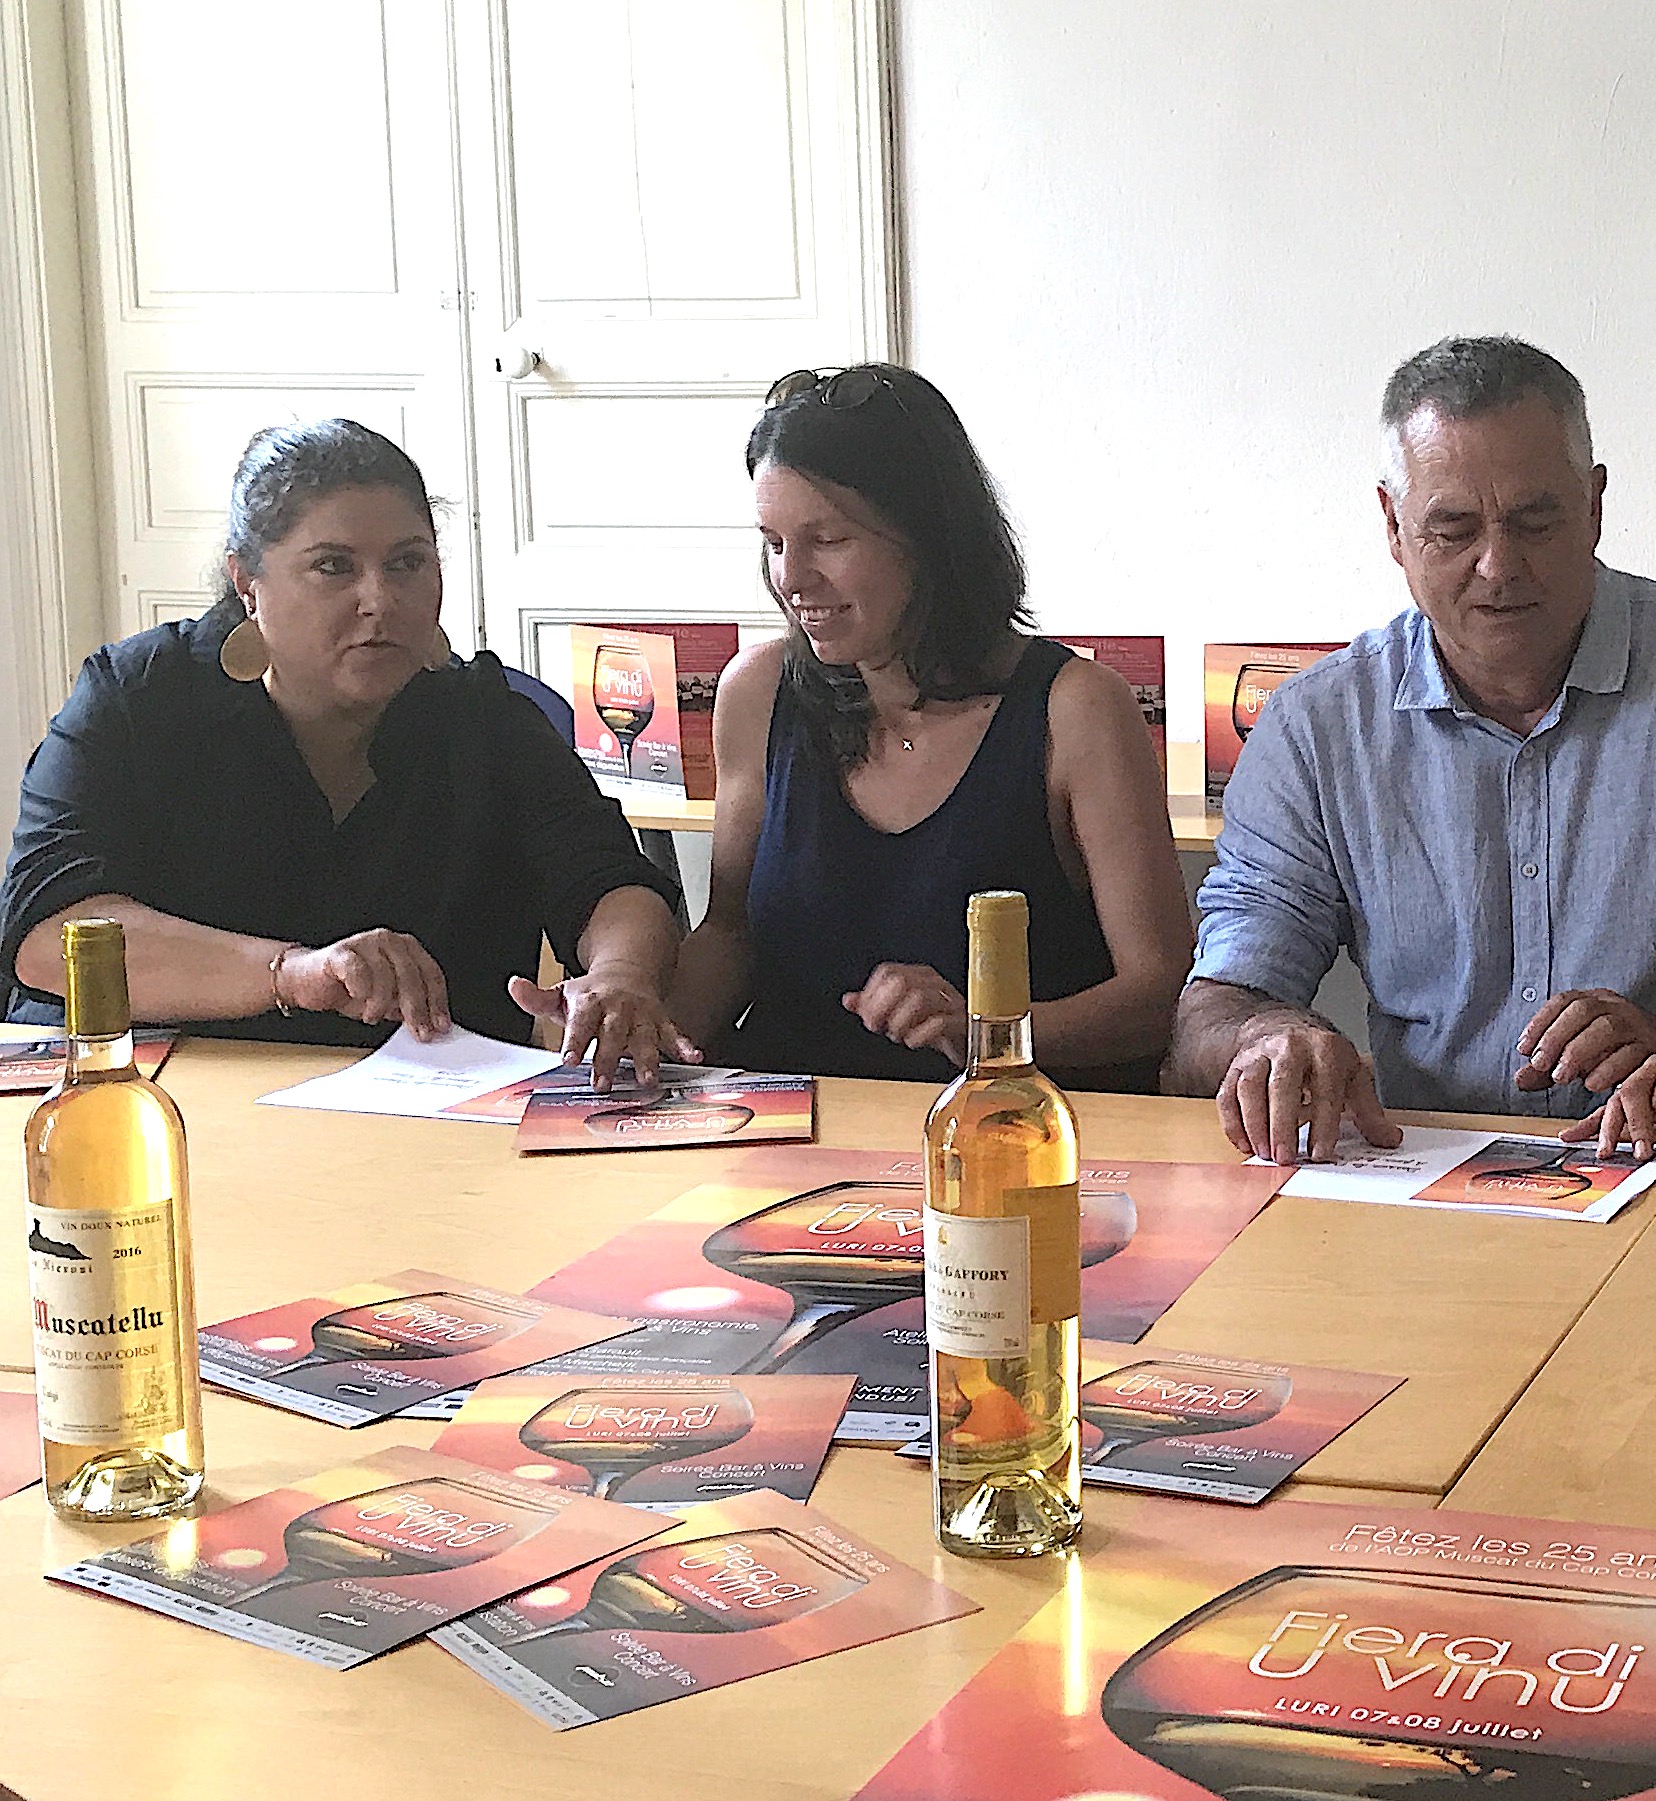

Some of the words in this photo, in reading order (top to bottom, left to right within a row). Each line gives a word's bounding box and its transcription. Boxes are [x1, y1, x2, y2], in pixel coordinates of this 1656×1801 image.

[1245, 685, 1273, 700] Fier
[116, 1214, 162, 1228] NATUREL
[824, 1203, 924, 1222] Fie
[112, 1246, 142, 1260] 2016
[820, 1241, 867, 1251] LURI
[871, 1243, 924, 1253] 07&0
[945, 1265, 1009, 1281] GAFFORY
[33, 1296, 164, 1336] Muscatellu
[85, 1350, 112, 1362] CAP
[116, 1344, 159, 1360] CORSE
[859, 1385, 924, 1395] MENT
[573, 1402, 667, 1418] Fiera
[681, 1402, 721, 1418] di
[769, 1462, 805, 1471] Vins
[394, 1493, 468, 1527] Fiera
[466, 1521, 514, 1538] di
[1344, 1522, 1461, 1549] Fêtez
[1472, 1534, 1531, 1556] les
[1543, 1541, 1597, 1563] 25
[1328, 1541, 1359, 1553] de
[1361, 1542, 1431, 1558] l'AOP
[1434, 1550, 1519, 1568] Muscat
[1525, 1558, 1556, 1571] du
[1561, 1561, 1612, 1577] Cap
[715, 1543, 781, 1585] Fiera
[770, 1582, 819, 1602] di
[1269, 1610, 1513, 1667] Fiera
[1547, 1642, 1646, 1682] di
[1374, 1653, 1626, 1714] vinu
[1274, 1697, 1342, 1718] LURI
[1349, 1706, 1442, 1731] 07&08
[1447, 1717, 1544, 1742] juillet
